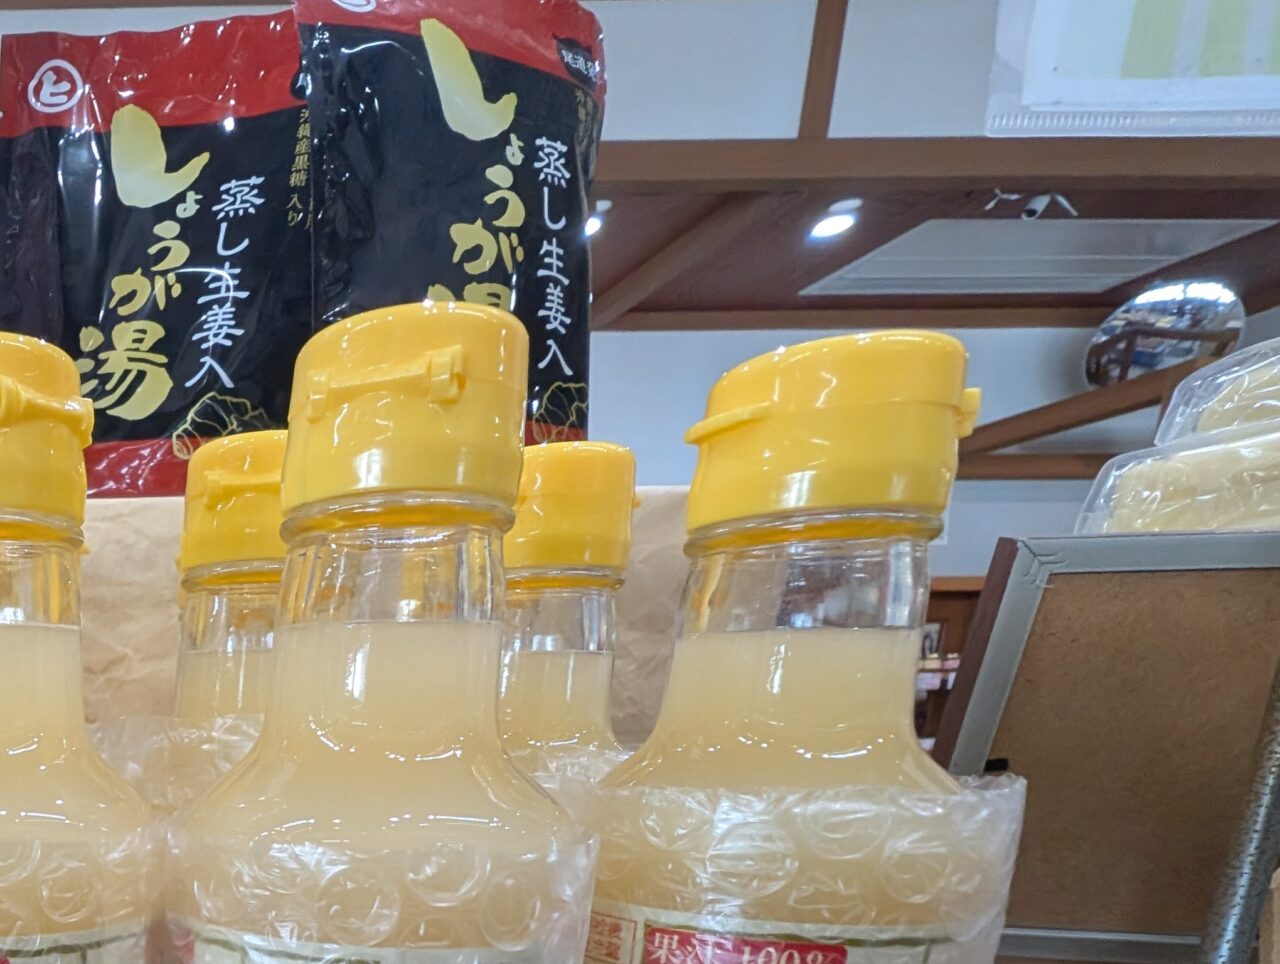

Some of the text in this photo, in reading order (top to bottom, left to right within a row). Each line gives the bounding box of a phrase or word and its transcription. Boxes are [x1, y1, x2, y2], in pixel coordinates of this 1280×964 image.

[80, 104, 209, 421] しょうが湯
[184, 176, 265, 389] 蒸し生姜入
[533, 136, 573, 376] 蒸し生姜入
